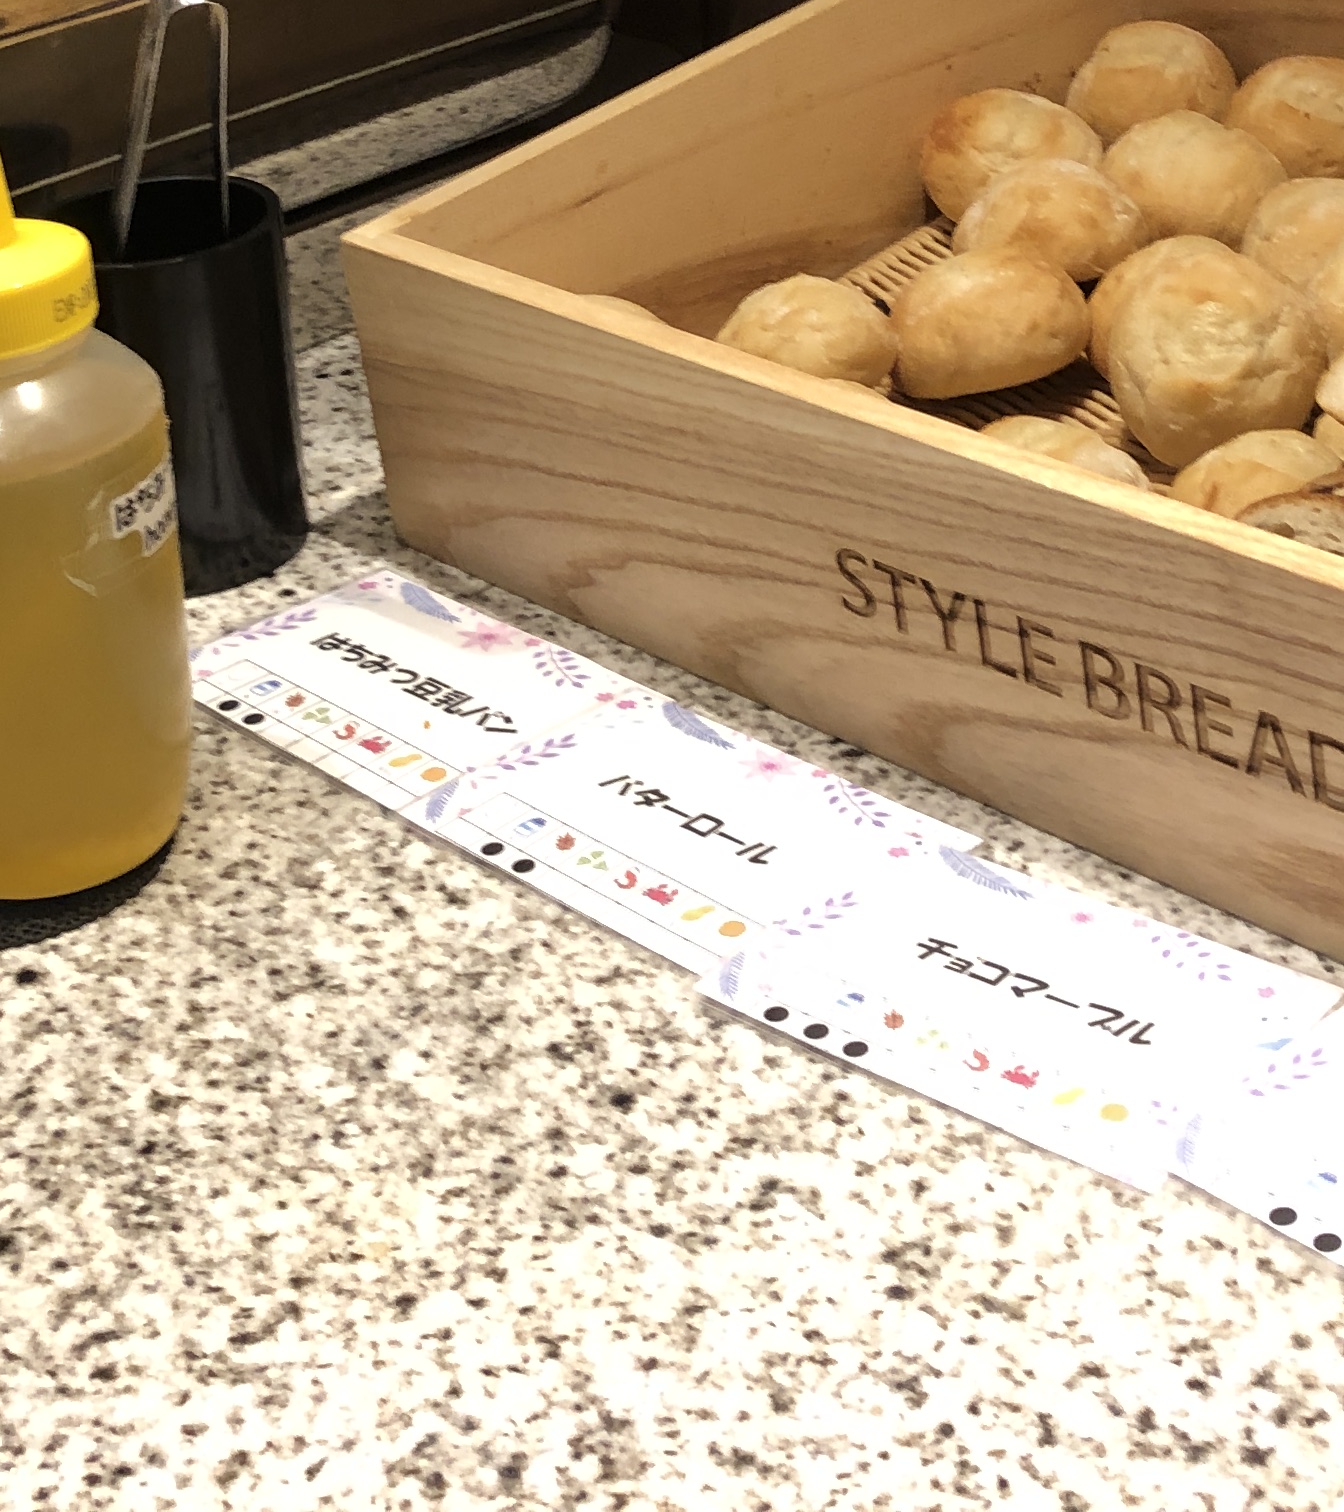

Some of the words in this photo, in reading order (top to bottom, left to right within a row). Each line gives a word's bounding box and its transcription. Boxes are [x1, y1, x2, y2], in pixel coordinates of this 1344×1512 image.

[835, 547, 1063, 698] STYLE
[309, 632, 519, 734] はちみつ豆乳パン
[597, 774, 778, 865] バターロール
